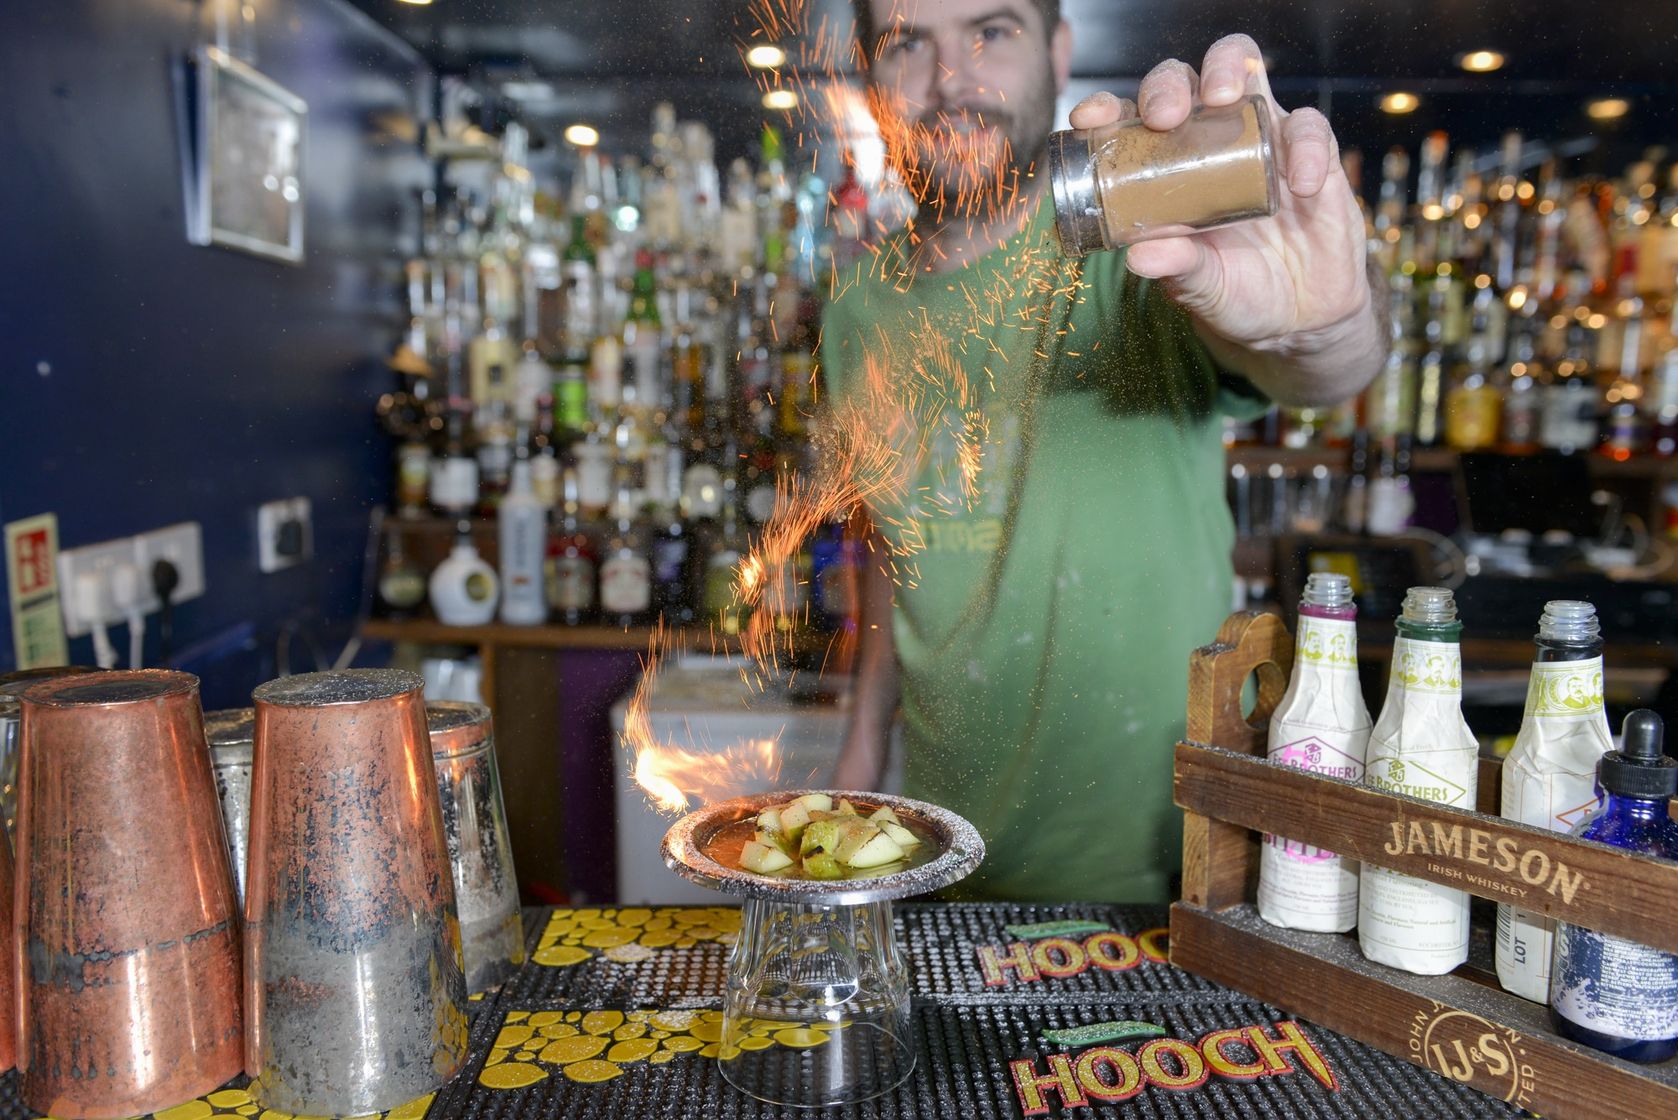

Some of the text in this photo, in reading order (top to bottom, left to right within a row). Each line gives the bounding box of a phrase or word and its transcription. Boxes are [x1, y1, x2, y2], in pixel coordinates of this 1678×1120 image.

[1384, 821, 1584, 905] JAMESON
[1428, 863, 1462, 879] IRISH
[1467, 874, 1528, 898] WHISKEY
[1514, 937, 1527, 964] LOT
[1409, 1010, 1429, 1064] JOHN
[1009, 1020, 1340, 1117] HOOCH
